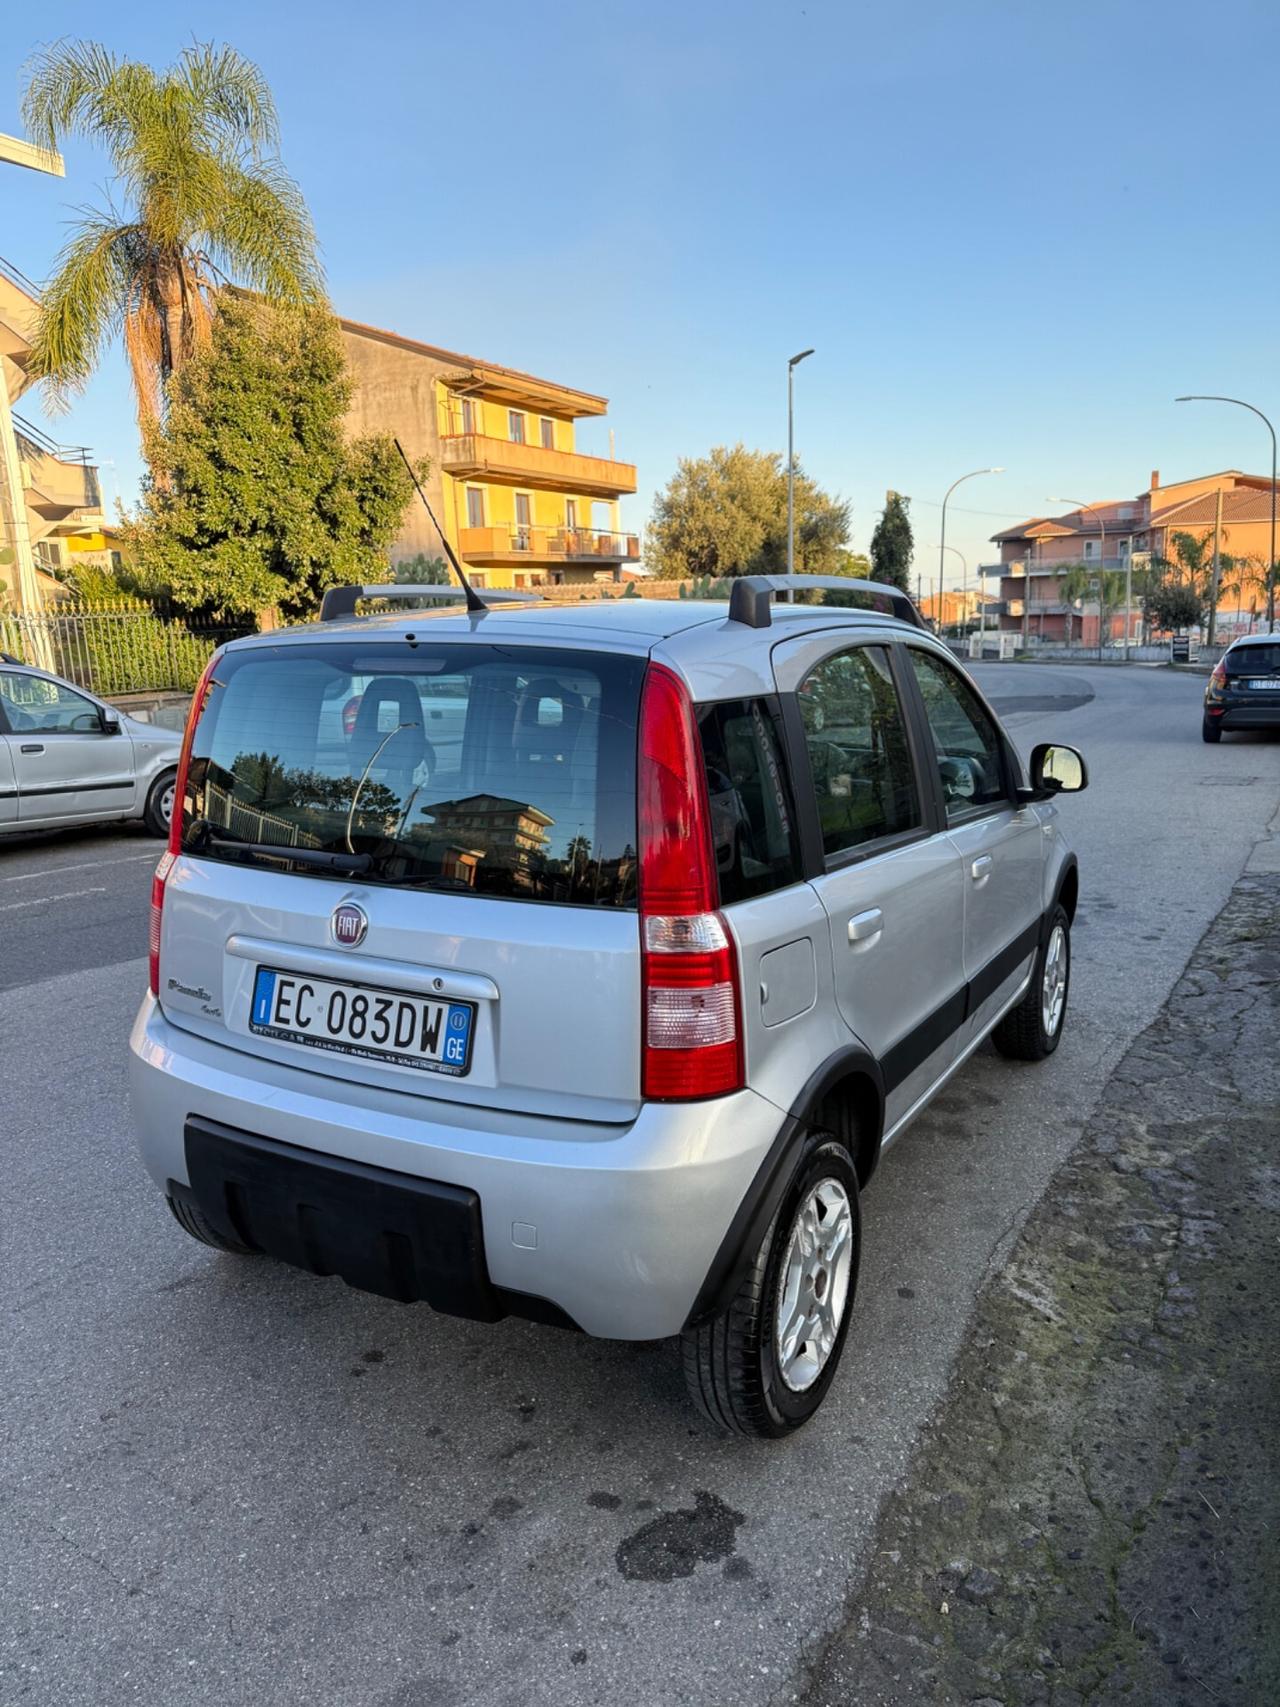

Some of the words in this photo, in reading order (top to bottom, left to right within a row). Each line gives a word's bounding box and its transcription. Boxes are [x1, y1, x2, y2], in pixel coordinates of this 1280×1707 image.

[337, 915, 360, 937] FIAT
[259, 999, 266, 1019] I
[274, 979, 315, 1028] EC
[326, 990, 443, 1055] 083DW
[447, 1037, 464, 1060] GE
